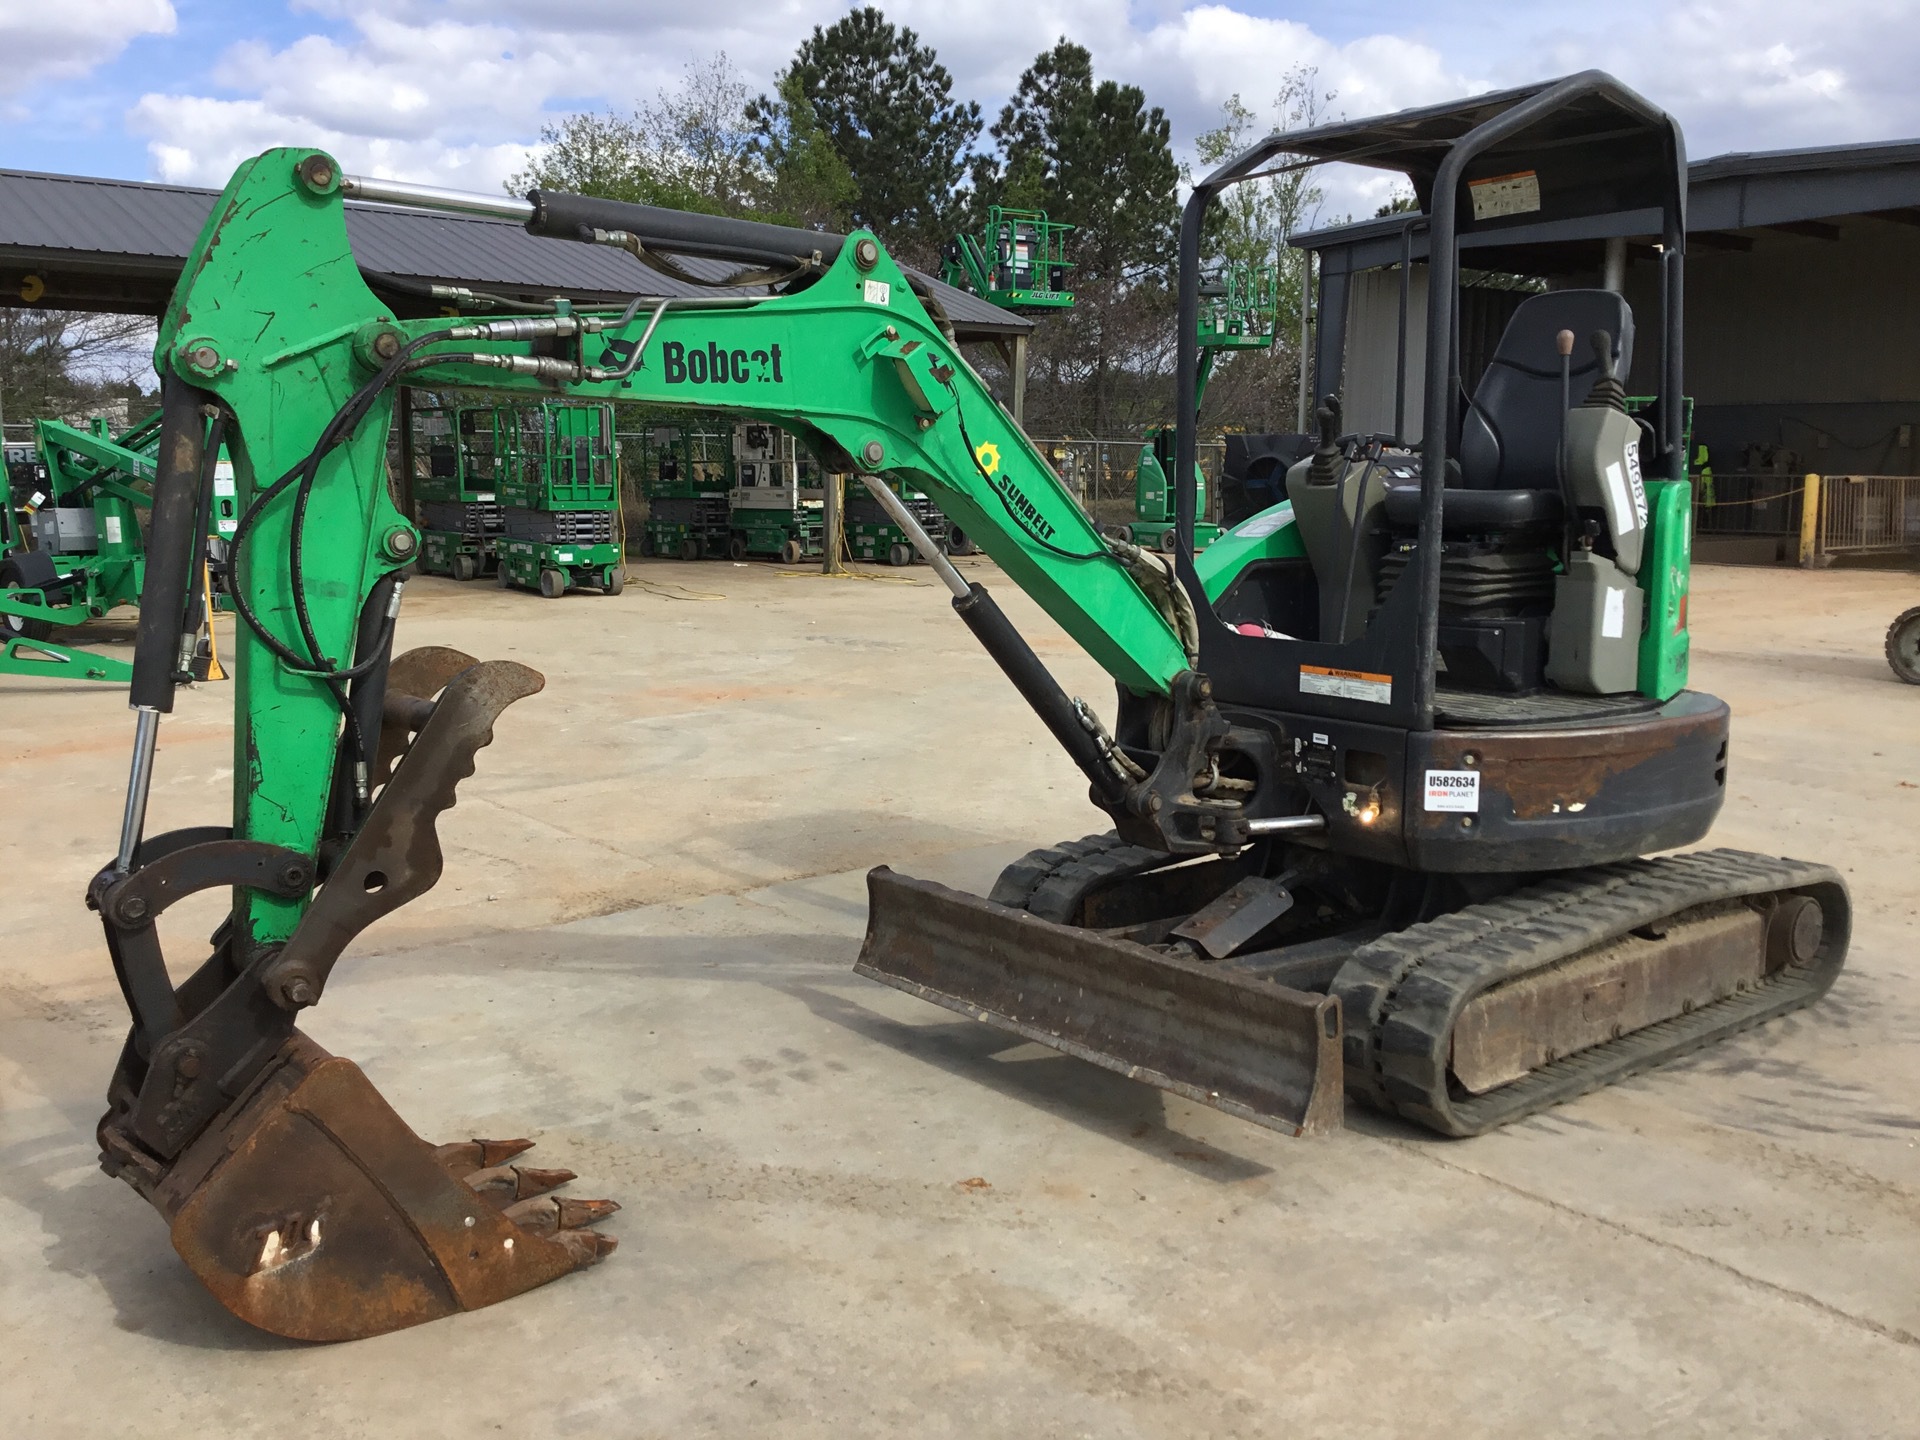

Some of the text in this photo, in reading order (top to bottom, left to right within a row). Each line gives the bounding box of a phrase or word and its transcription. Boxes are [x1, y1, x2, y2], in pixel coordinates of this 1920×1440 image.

[1045, 292, 1060, 300] LIFT
[998, 474, 1056, 540] SUNBELT
[1334, 670, 1363, 679] WARNING
[1429, 776, 1475, 788] U582634
